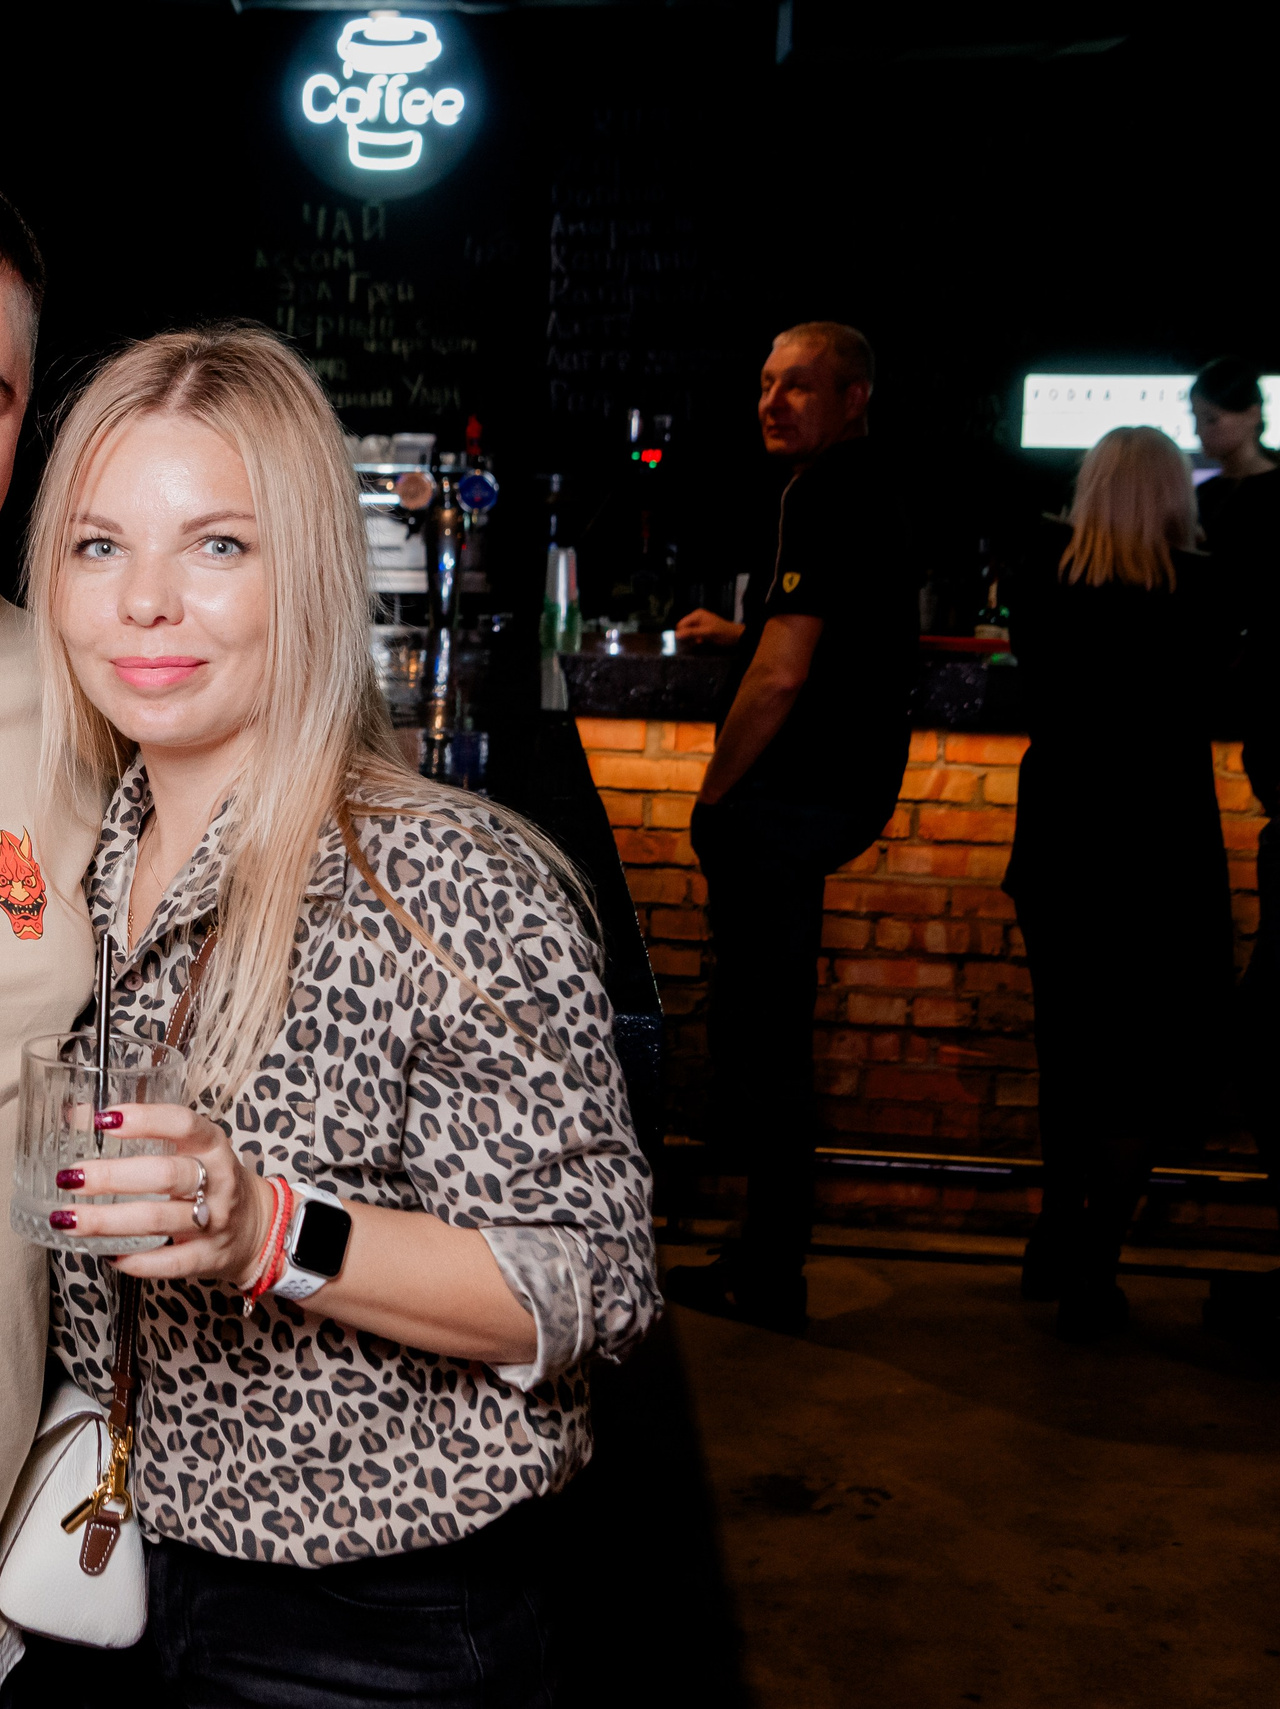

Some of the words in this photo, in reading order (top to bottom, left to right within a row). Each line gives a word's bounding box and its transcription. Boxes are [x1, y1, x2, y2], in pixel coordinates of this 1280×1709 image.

[302, 73, 465, 126] Coffee
[302, 201, 387, 242] ЧАЙ
[1032, 388, 1112, 401] VODKA
